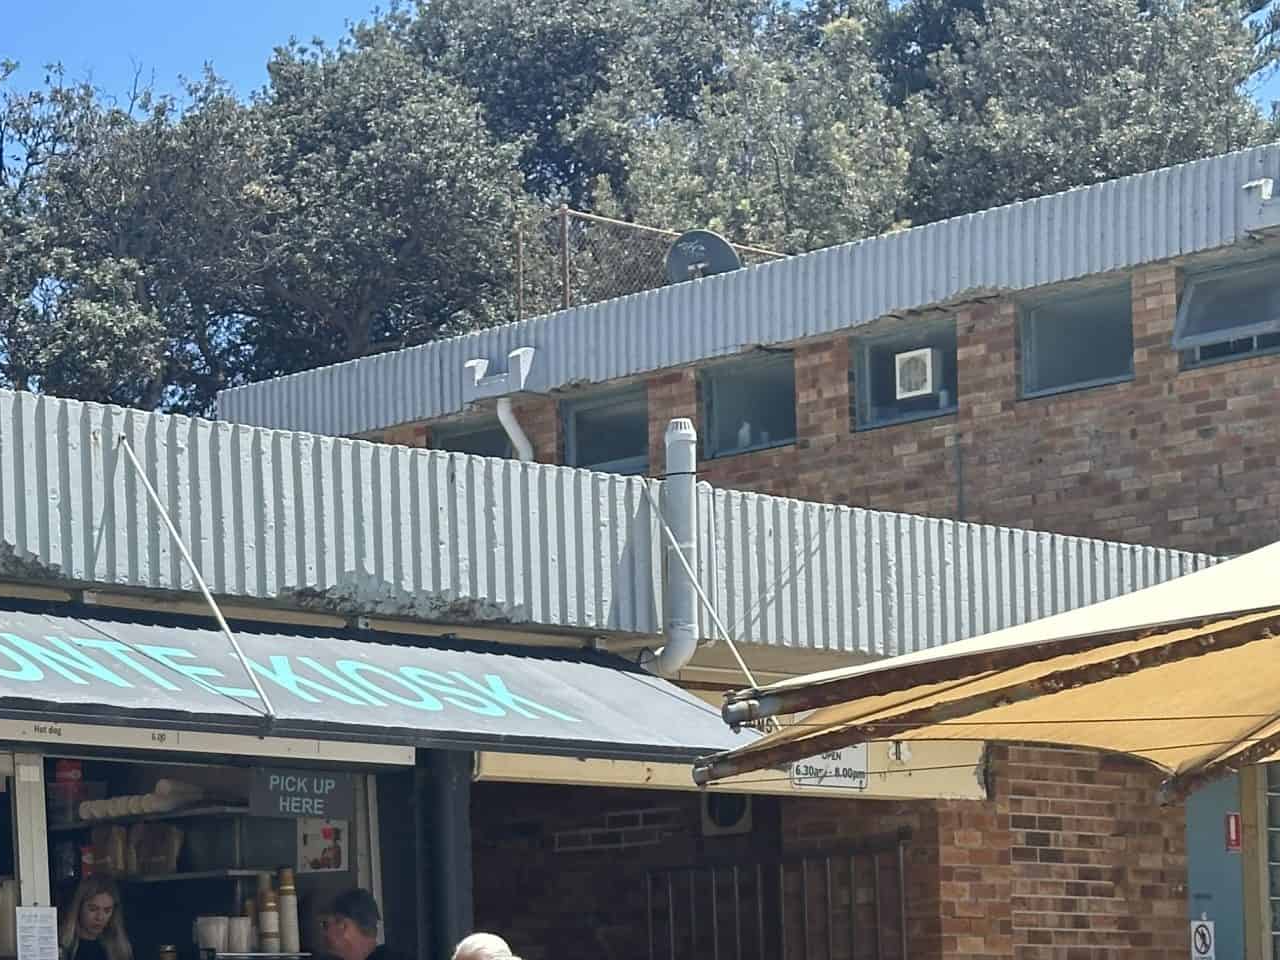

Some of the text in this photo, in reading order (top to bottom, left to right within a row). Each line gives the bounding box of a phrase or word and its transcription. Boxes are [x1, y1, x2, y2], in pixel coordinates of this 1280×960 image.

[229, 653, 583, 722] KIOSK
[33, 725, 48, 735] Hot
[48, 725, 63, 737] dog
[269, 774, 336, 795] PICK UP
[279, 796, 325, 815] HERE
